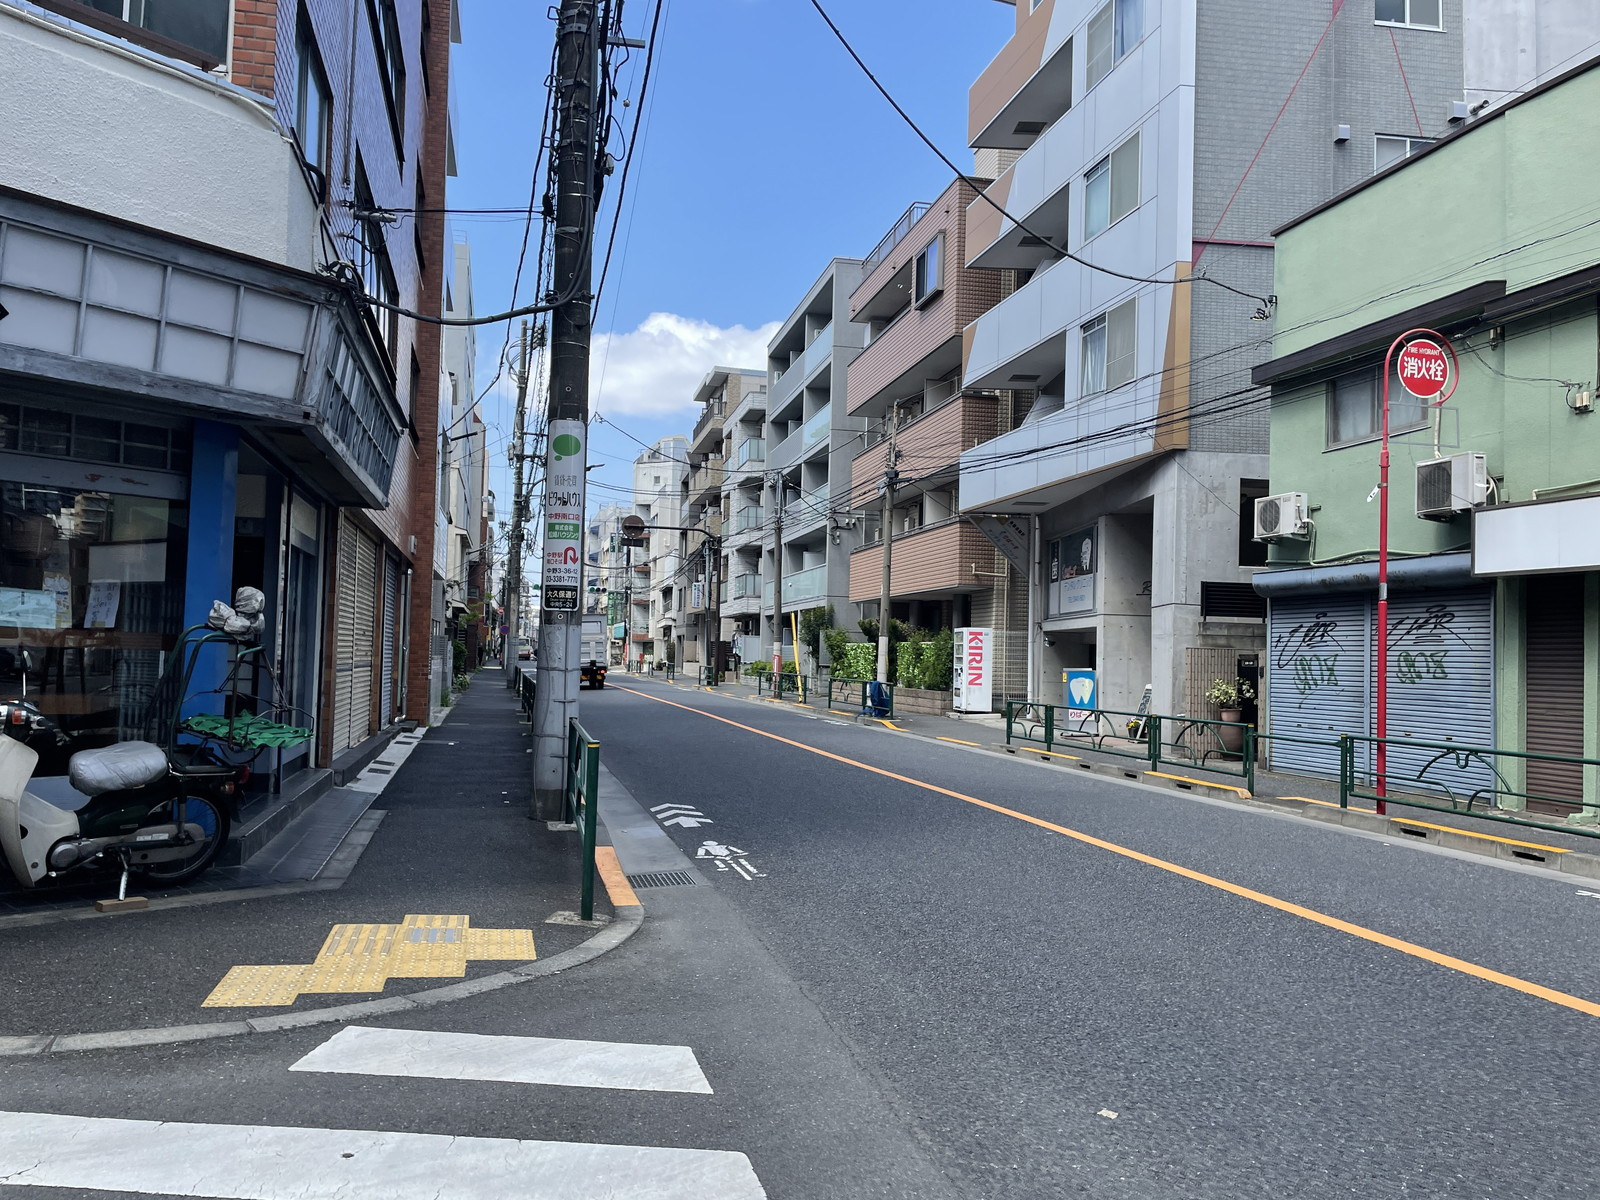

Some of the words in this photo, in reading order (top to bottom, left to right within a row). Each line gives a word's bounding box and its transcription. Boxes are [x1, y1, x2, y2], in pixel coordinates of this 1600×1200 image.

[1408, 346, 1418, 354] FIRE
[1419, 347, 1440, 356] HYDRANT
[1403, 356, 1444, 381] 消火栓
[548, 491, 581, 507] ピタットハウス
[548, 513, 580, 521] 中野南口店
[547, 590, 577, 599] 大久保通り
[968, 631, 983, 686] KIRIN
